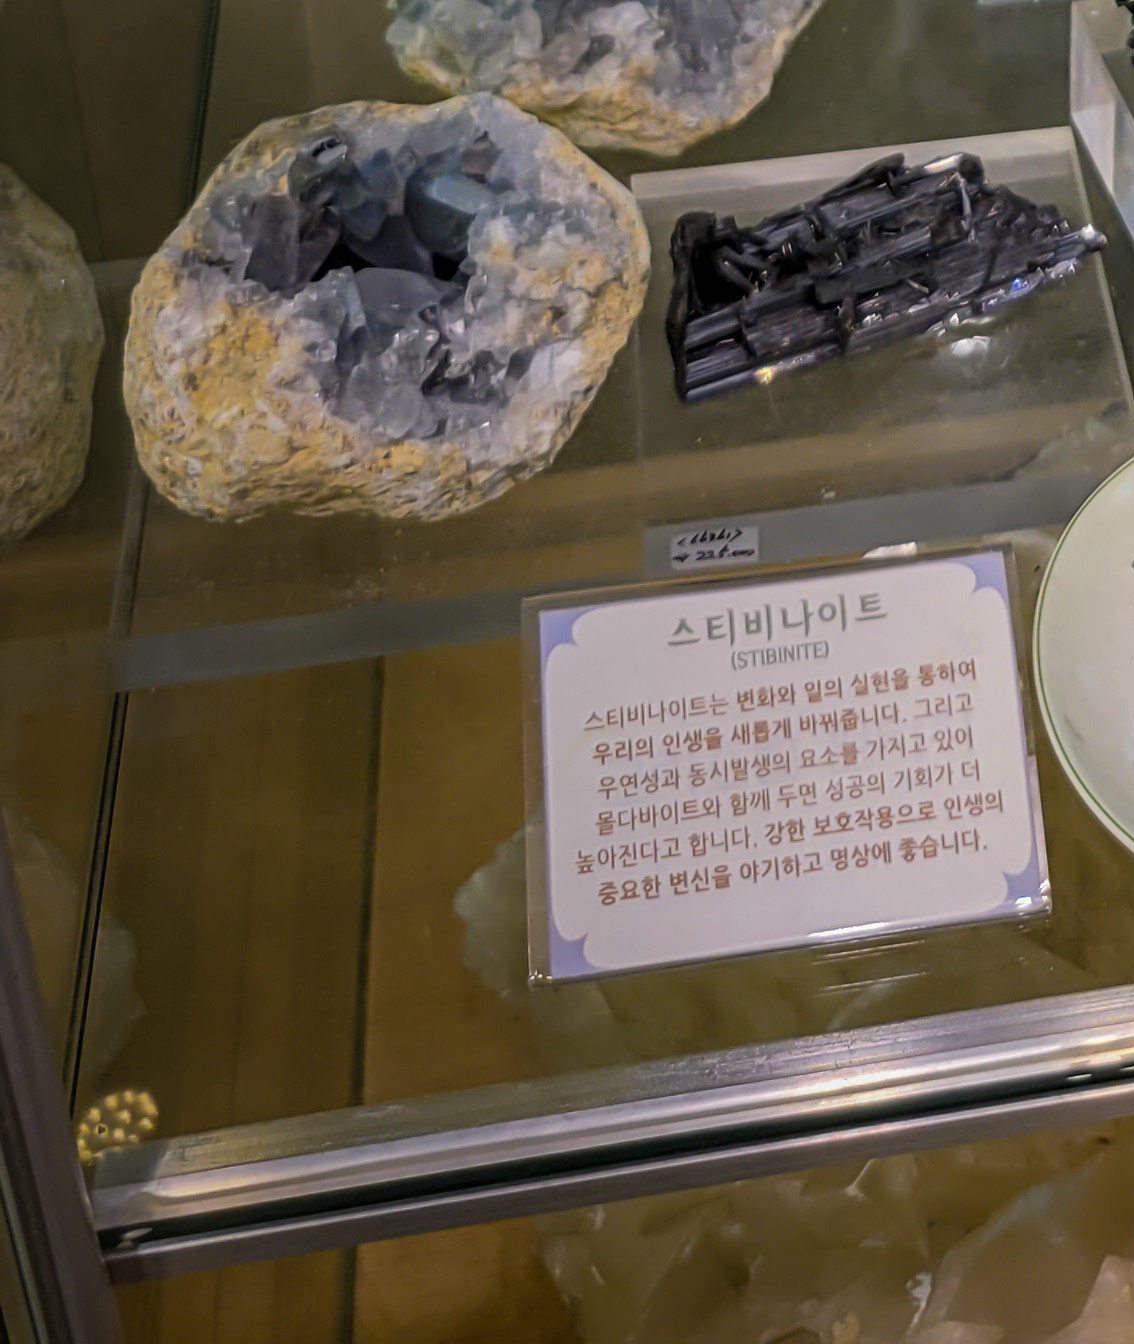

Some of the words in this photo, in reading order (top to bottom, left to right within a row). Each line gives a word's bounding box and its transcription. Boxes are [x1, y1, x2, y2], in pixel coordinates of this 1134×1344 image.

[667, 593, 889, 648] 스티비나이트
[730, 640, 830, 672] (STIBINITE)
[583, 692, 730, 732] 스티비나이트는
[736, 683, 797, 712] 변화와
[804, 675, 843, 704] 일의
[850, 667, 911, 697] 실현을
[917, 657, 978, 687] 통하여
[591, 735, 655, 766] 우리의
[662, 726, 724, 756] 인생을
[730, 716, 792, 746] 새롭게
[799, 700, 908, 736] 바꿔줍니다.
[913, 691, 975, 719] 그리고
[595, 794, 722, 837] 몰다바이트와
[728, 786, 771, 817] 함께
[776, 781, 818, 810] 두면
[825, 770, 886, 803] 성공의
[893, 761, 955, 792] 기회가
[961, 758, 981, 783] 더
[597, 766, 681, 800] 우연성과
[688, 750, 791, 788] 동시발생의
[798, 740, 860, 769] 요소를
[866, 732, 928, 761] 가지고
[933, 723, 974, 753] 있어
[575, 837, 682, 875] 높아진다고
[688, 824, 759, 858] 합니다.
[764, 817, 805, 847] 강한
[812, 800, 937, 837] 보호작용으로
[943, 789, 1005, 821] 인생의
[597, 874, 662, 907] 중요한
[669, 864, 733, 896] 변신을
[740, 851, 823, 885] 야기하고
[830, 840, 893, 871] 명상에
[898, 827, 988, 864] 좋습니다.
